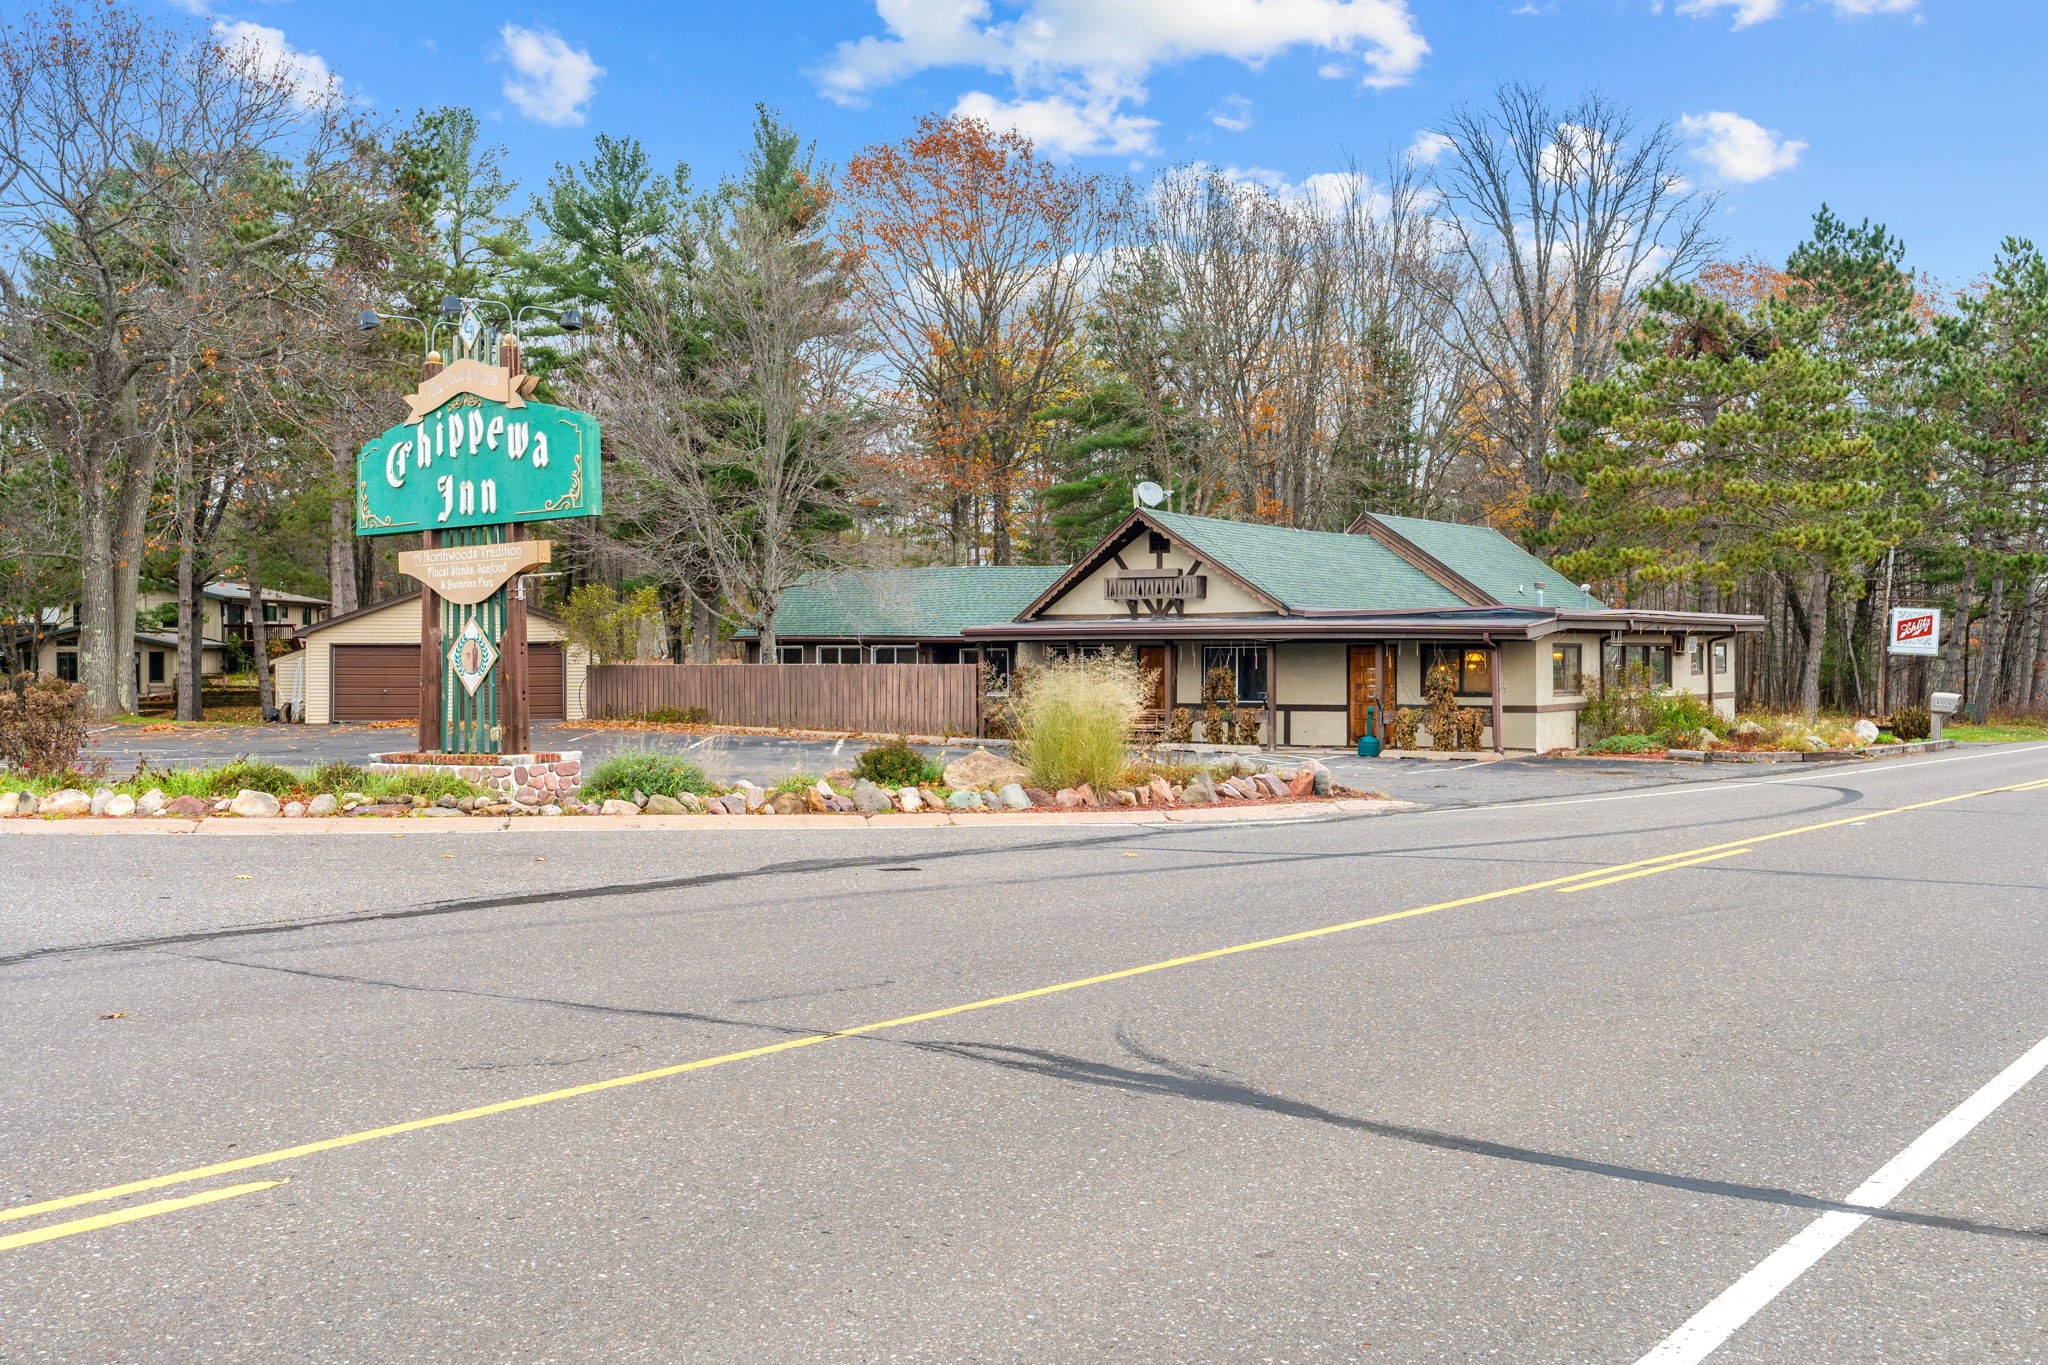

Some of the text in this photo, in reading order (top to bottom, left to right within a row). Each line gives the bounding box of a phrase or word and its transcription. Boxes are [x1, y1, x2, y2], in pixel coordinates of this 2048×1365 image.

[386, 409, 549, 488] Chippewa
[437, 474, 497, 522] Inn
[423, 550, 478, 563] Northwoods
[481, 546, 522, 558] Tradition
[428, 567, 449, 577] Finest
[477, 563, 507, 575] Seafood
[447, 580, 477, 590] Bavarian
[1900, 617, 1931, 638] Schlitz
